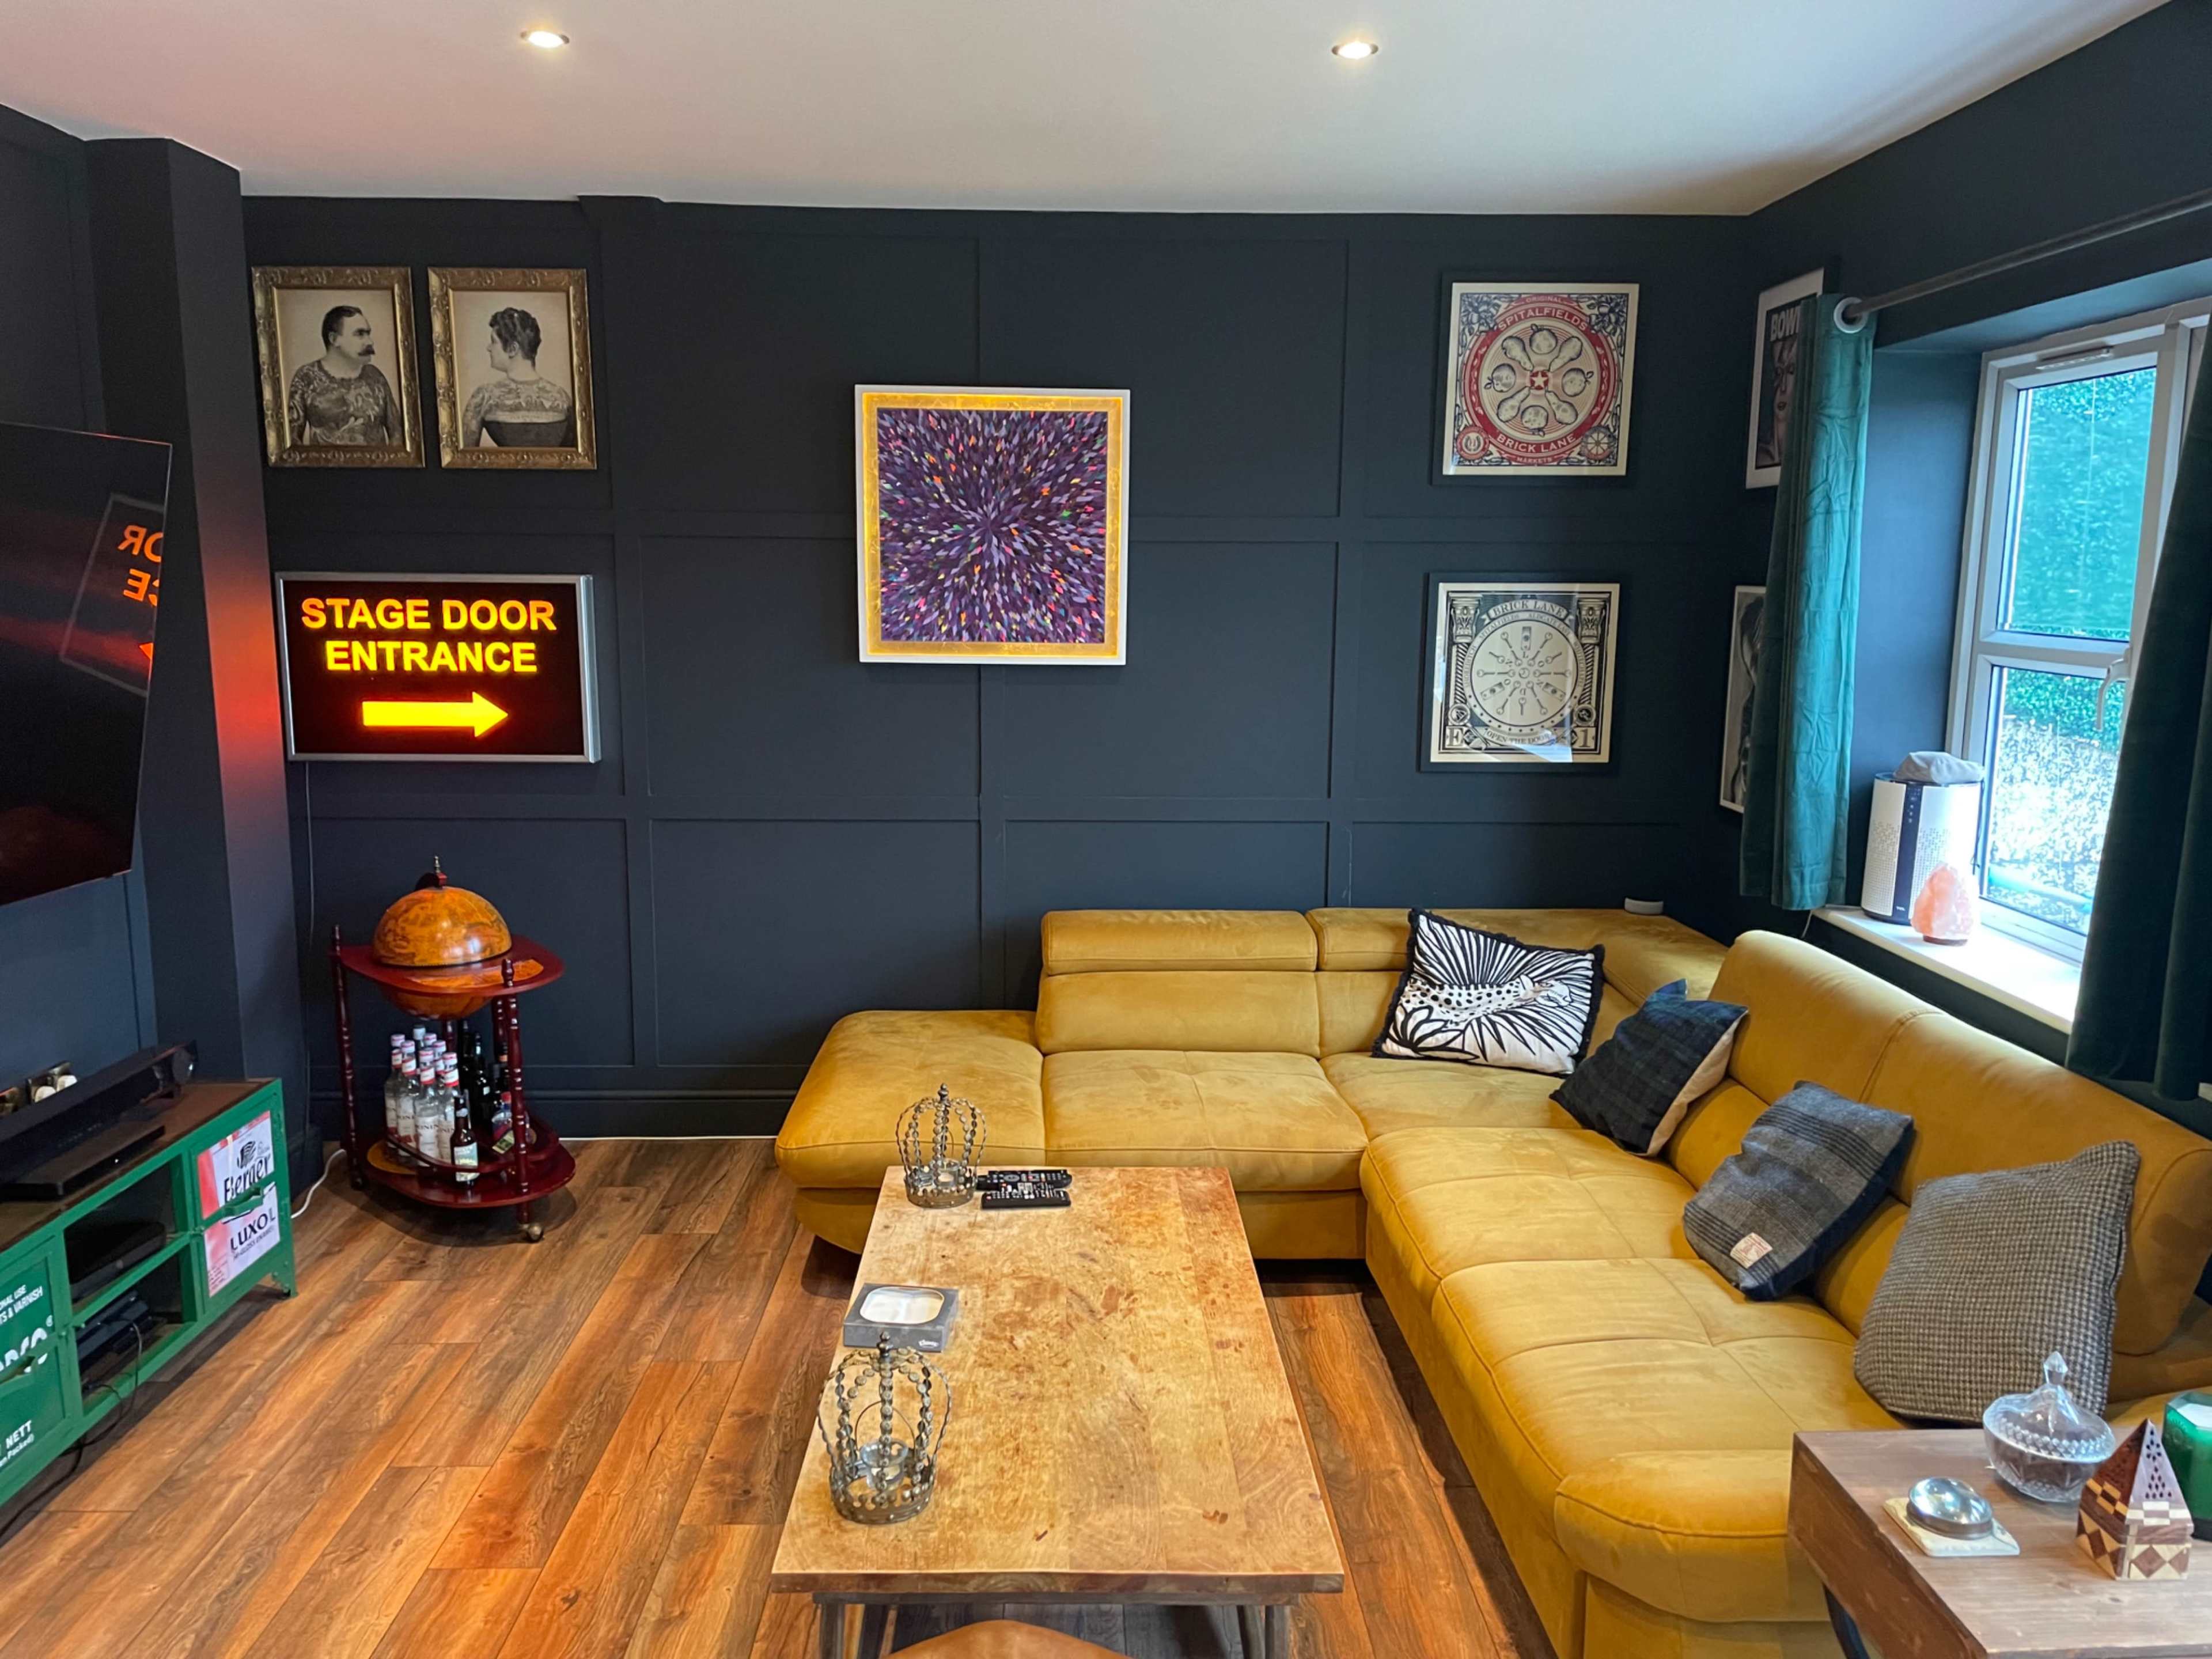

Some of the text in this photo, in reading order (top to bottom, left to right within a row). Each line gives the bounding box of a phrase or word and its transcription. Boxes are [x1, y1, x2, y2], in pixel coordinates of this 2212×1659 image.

[1498, 307, 1587, 331] SPITALFIELDS
[1497, 434, 1577, 452] BRICK LANE
[301, 598, 556, 631] STAGE DOOR
[1493, 600, 1564, 618] BRICK LANE
[325, 640, 537, 673] ENTRANCE
[1447, 727, 1463, 747] E
[1487, 730, 1507, 743] OPEN
[230, 1208, 276, 1251] LUXOL
[14, 1285, 43, 1314] VARNISH
[6, 1419, 32, 1449] NETT
